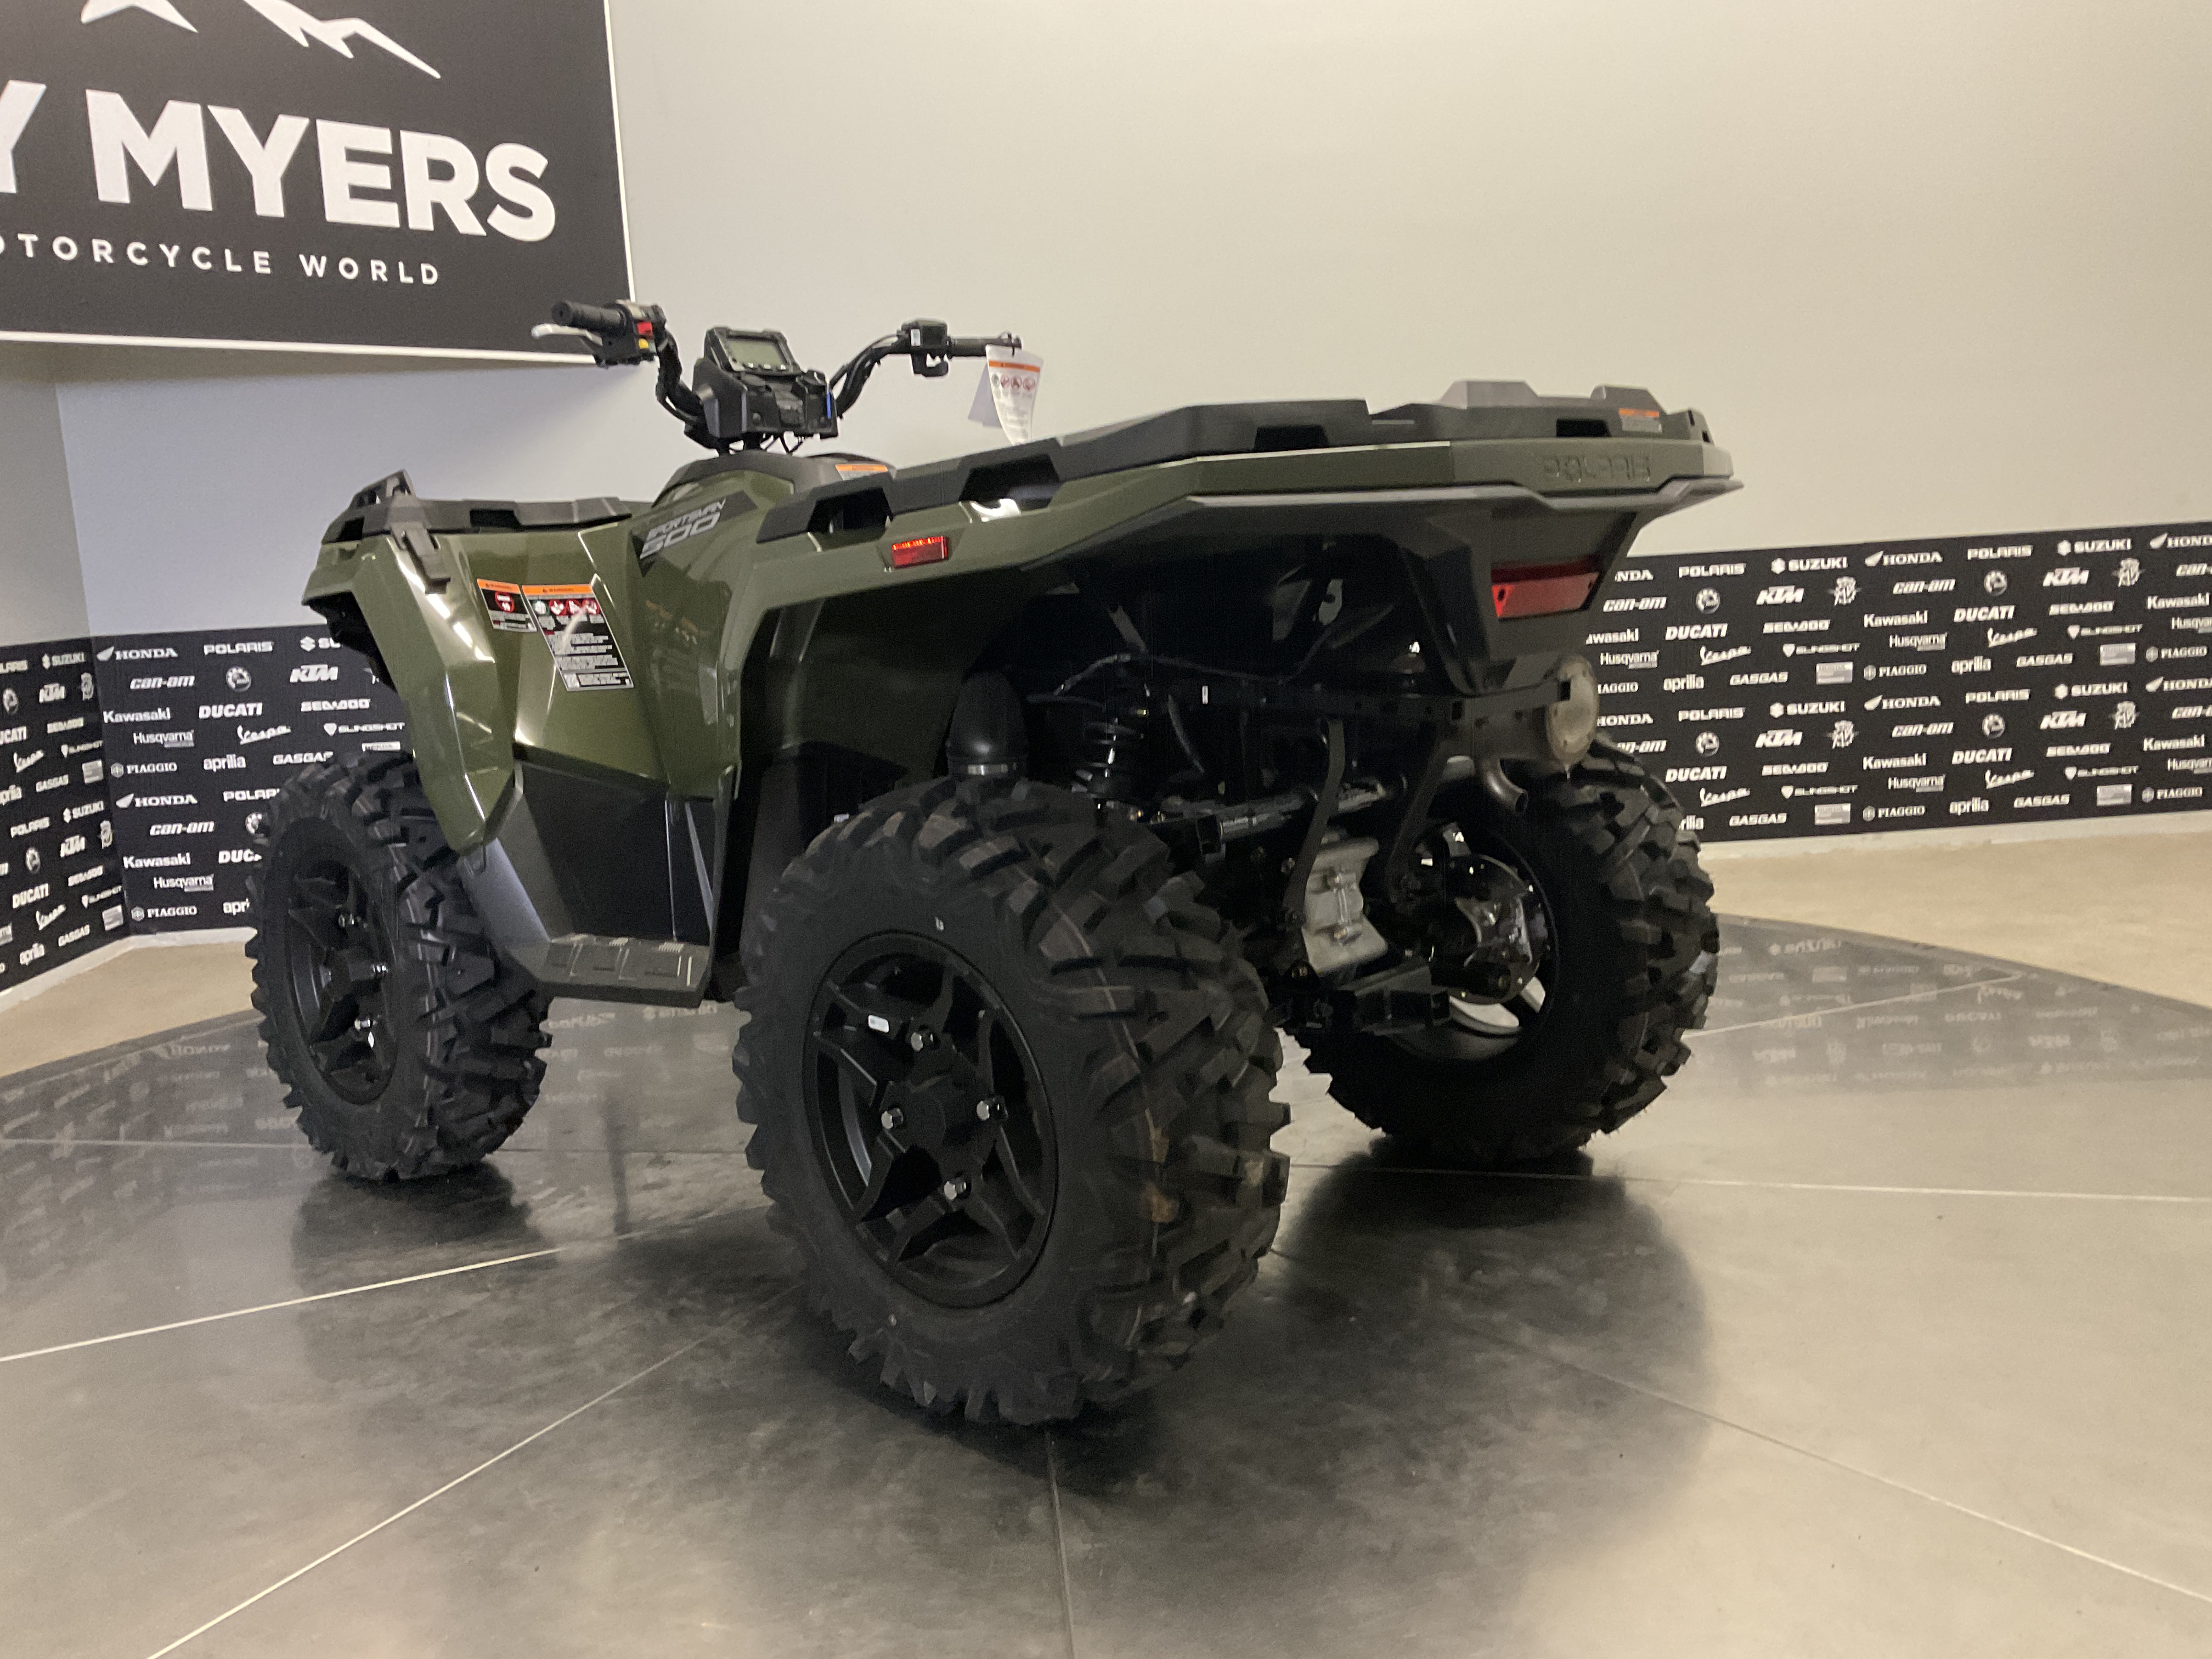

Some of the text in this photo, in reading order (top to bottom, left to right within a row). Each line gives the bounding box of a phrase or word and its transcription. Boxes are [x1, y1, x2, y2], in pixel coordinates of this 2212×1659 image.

[86, 89, 555, 244] MYERS
[0, 233, 438, 284] TORCYCLE WORLD
[2074, 538, 2131, 553] SUZUKI
[2167, 535, 2212, 548] HOND
[1883, 552, 1942, 566] HONDA
[1967, 545, 2032, 560] POLARIS
[1679, 563, 1746, 578] POLARIS
[1788, 557, 1847, 571] SUZUKI
[2043, 567, 2089, 586] KTM
[1757, 585, 1804, 605] KTM
[2147, 592, 2209, 609] Kawasaki
[1864, 611, 1927, 628] Kawasaki
[1954, 606, 2015, 622] DUCATI
[1585, 628, 1639, 644] awasaki
[1666, 623, 1728, 640] DUCATI
[115, 648, 178, 660] HONDA
[204, 641, 273, 655] POLARIS
[2161, 646, 2207, 658] PIAGGIO
[1951, 656, 1991, 674] aprilia
[2017, 653, 2073, 667] GASGAS
[290, 664, 338, 682] KTM
[1880, 664, 1926, 677] PIAGGIO
[1663, 674, 1704, 692] aprilia
[1730, 672, 1788, 685] GASGAS
[2164, 678, 2212, 691] HOND
[1598, 682, 1638, 694] IAGGIO
[2072, 682, 2127, 696] SUZUKI
[1882, 696, 1941, 709] HONDA
[1966, 689, 2030, 703] POLARIS
[103, 707, 171, 723] Kawasaki
[199, 702, 262, 719] DUCATI
[1679, 708, 1745, 721] POLARIS
[1787, 701, 1844, 715] SUZUKI
[2040, 710, 2086, 729] KTM
[1756, 729, 1802, 748] KTM
[2143, 734, 2204, 751] Kawasaki
[204, 754, 246, 772] aprilia
[1863, 753, 1926, 770] Kawasaki
[1952, 748, 2012, 764] DUCATI
[127, 763, 177, 774] PIAGGIO
[1666, 766, 1726, 782] DUCATI
[135, 794, 198, 807] HONDA
[2157, 787, 2202, 799] PIAGGIO
[1950, 797, 1989, 815] aprilia
[2014, 794, 2070, 808] GASGAS
[72, 800, 104, 819] SUZUKI
[1878, 806, 1925, 819] PIAGGIO
[1729, 813, 1787, 826] GASGAS
[123, 853, 190, 868] Kawasaki
[13, 883, 49, 909] DUCATI
[147, 906, 197, 917] PIAGGIO
